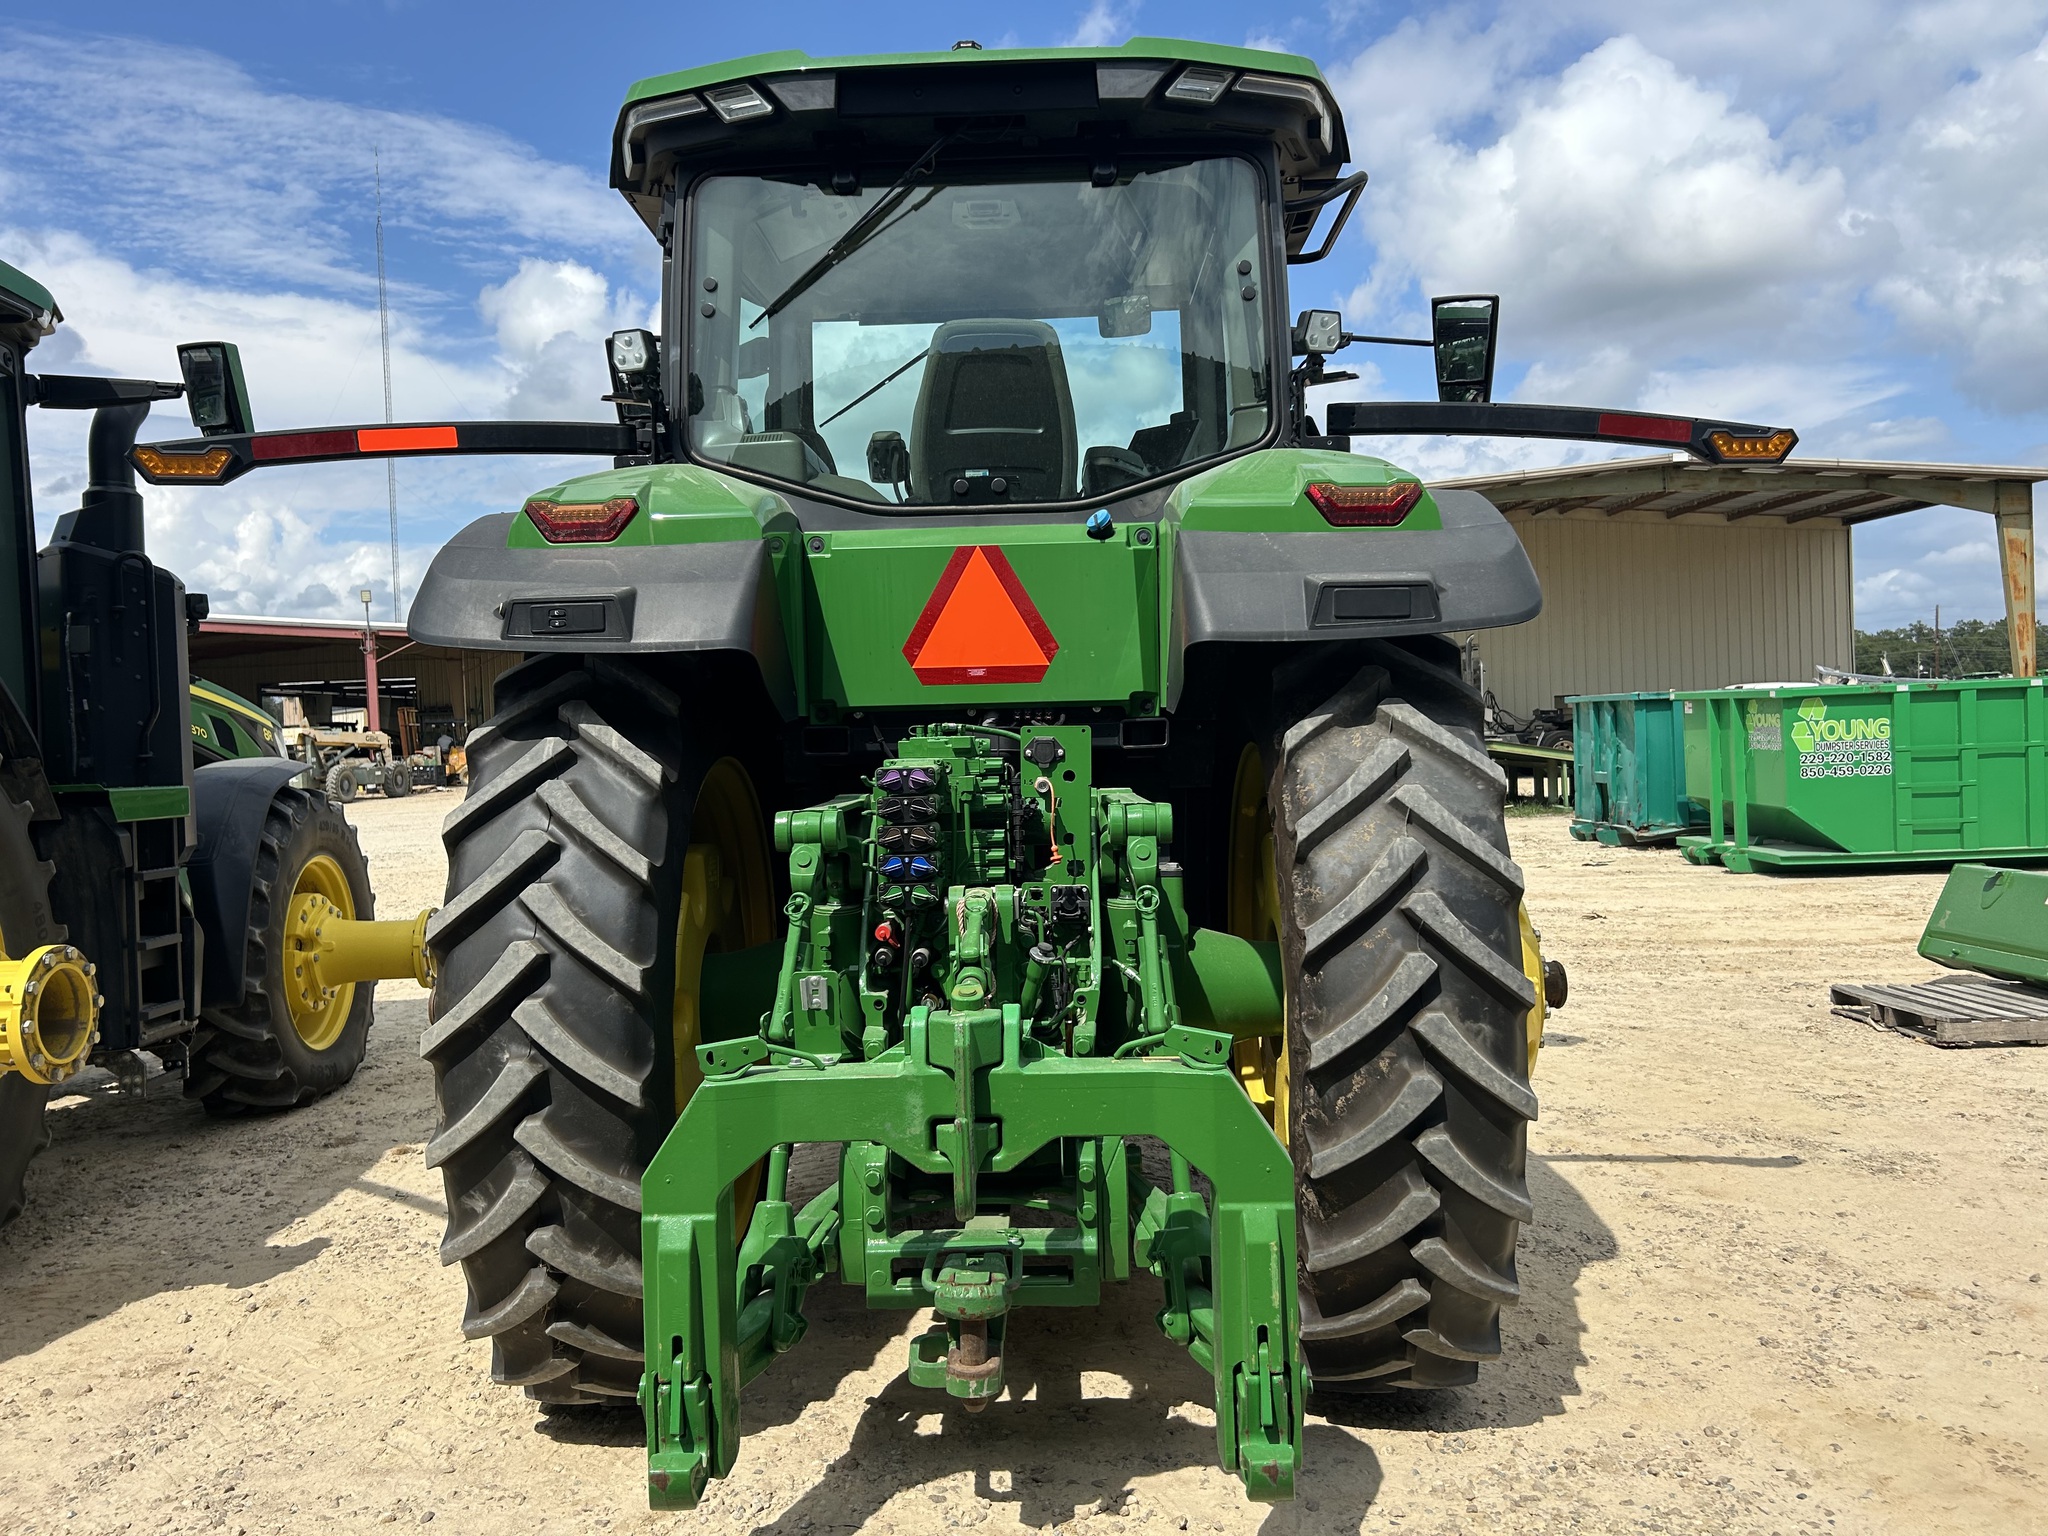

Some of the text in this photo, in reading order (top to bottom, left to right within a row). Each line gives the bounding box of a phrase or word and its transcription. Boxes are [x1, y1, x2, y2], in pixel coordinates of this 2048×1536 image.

[1752, 713, 1780, 728] YOUNG
[1809, 718, 1890, 741] YOUNG
[1815, 740, 1889, 751] DUMPSTER SERVICES
[1800, 752, 1891, 764] 229-220-1582
[1800, 765, 1891, 778] 850-459-0226
